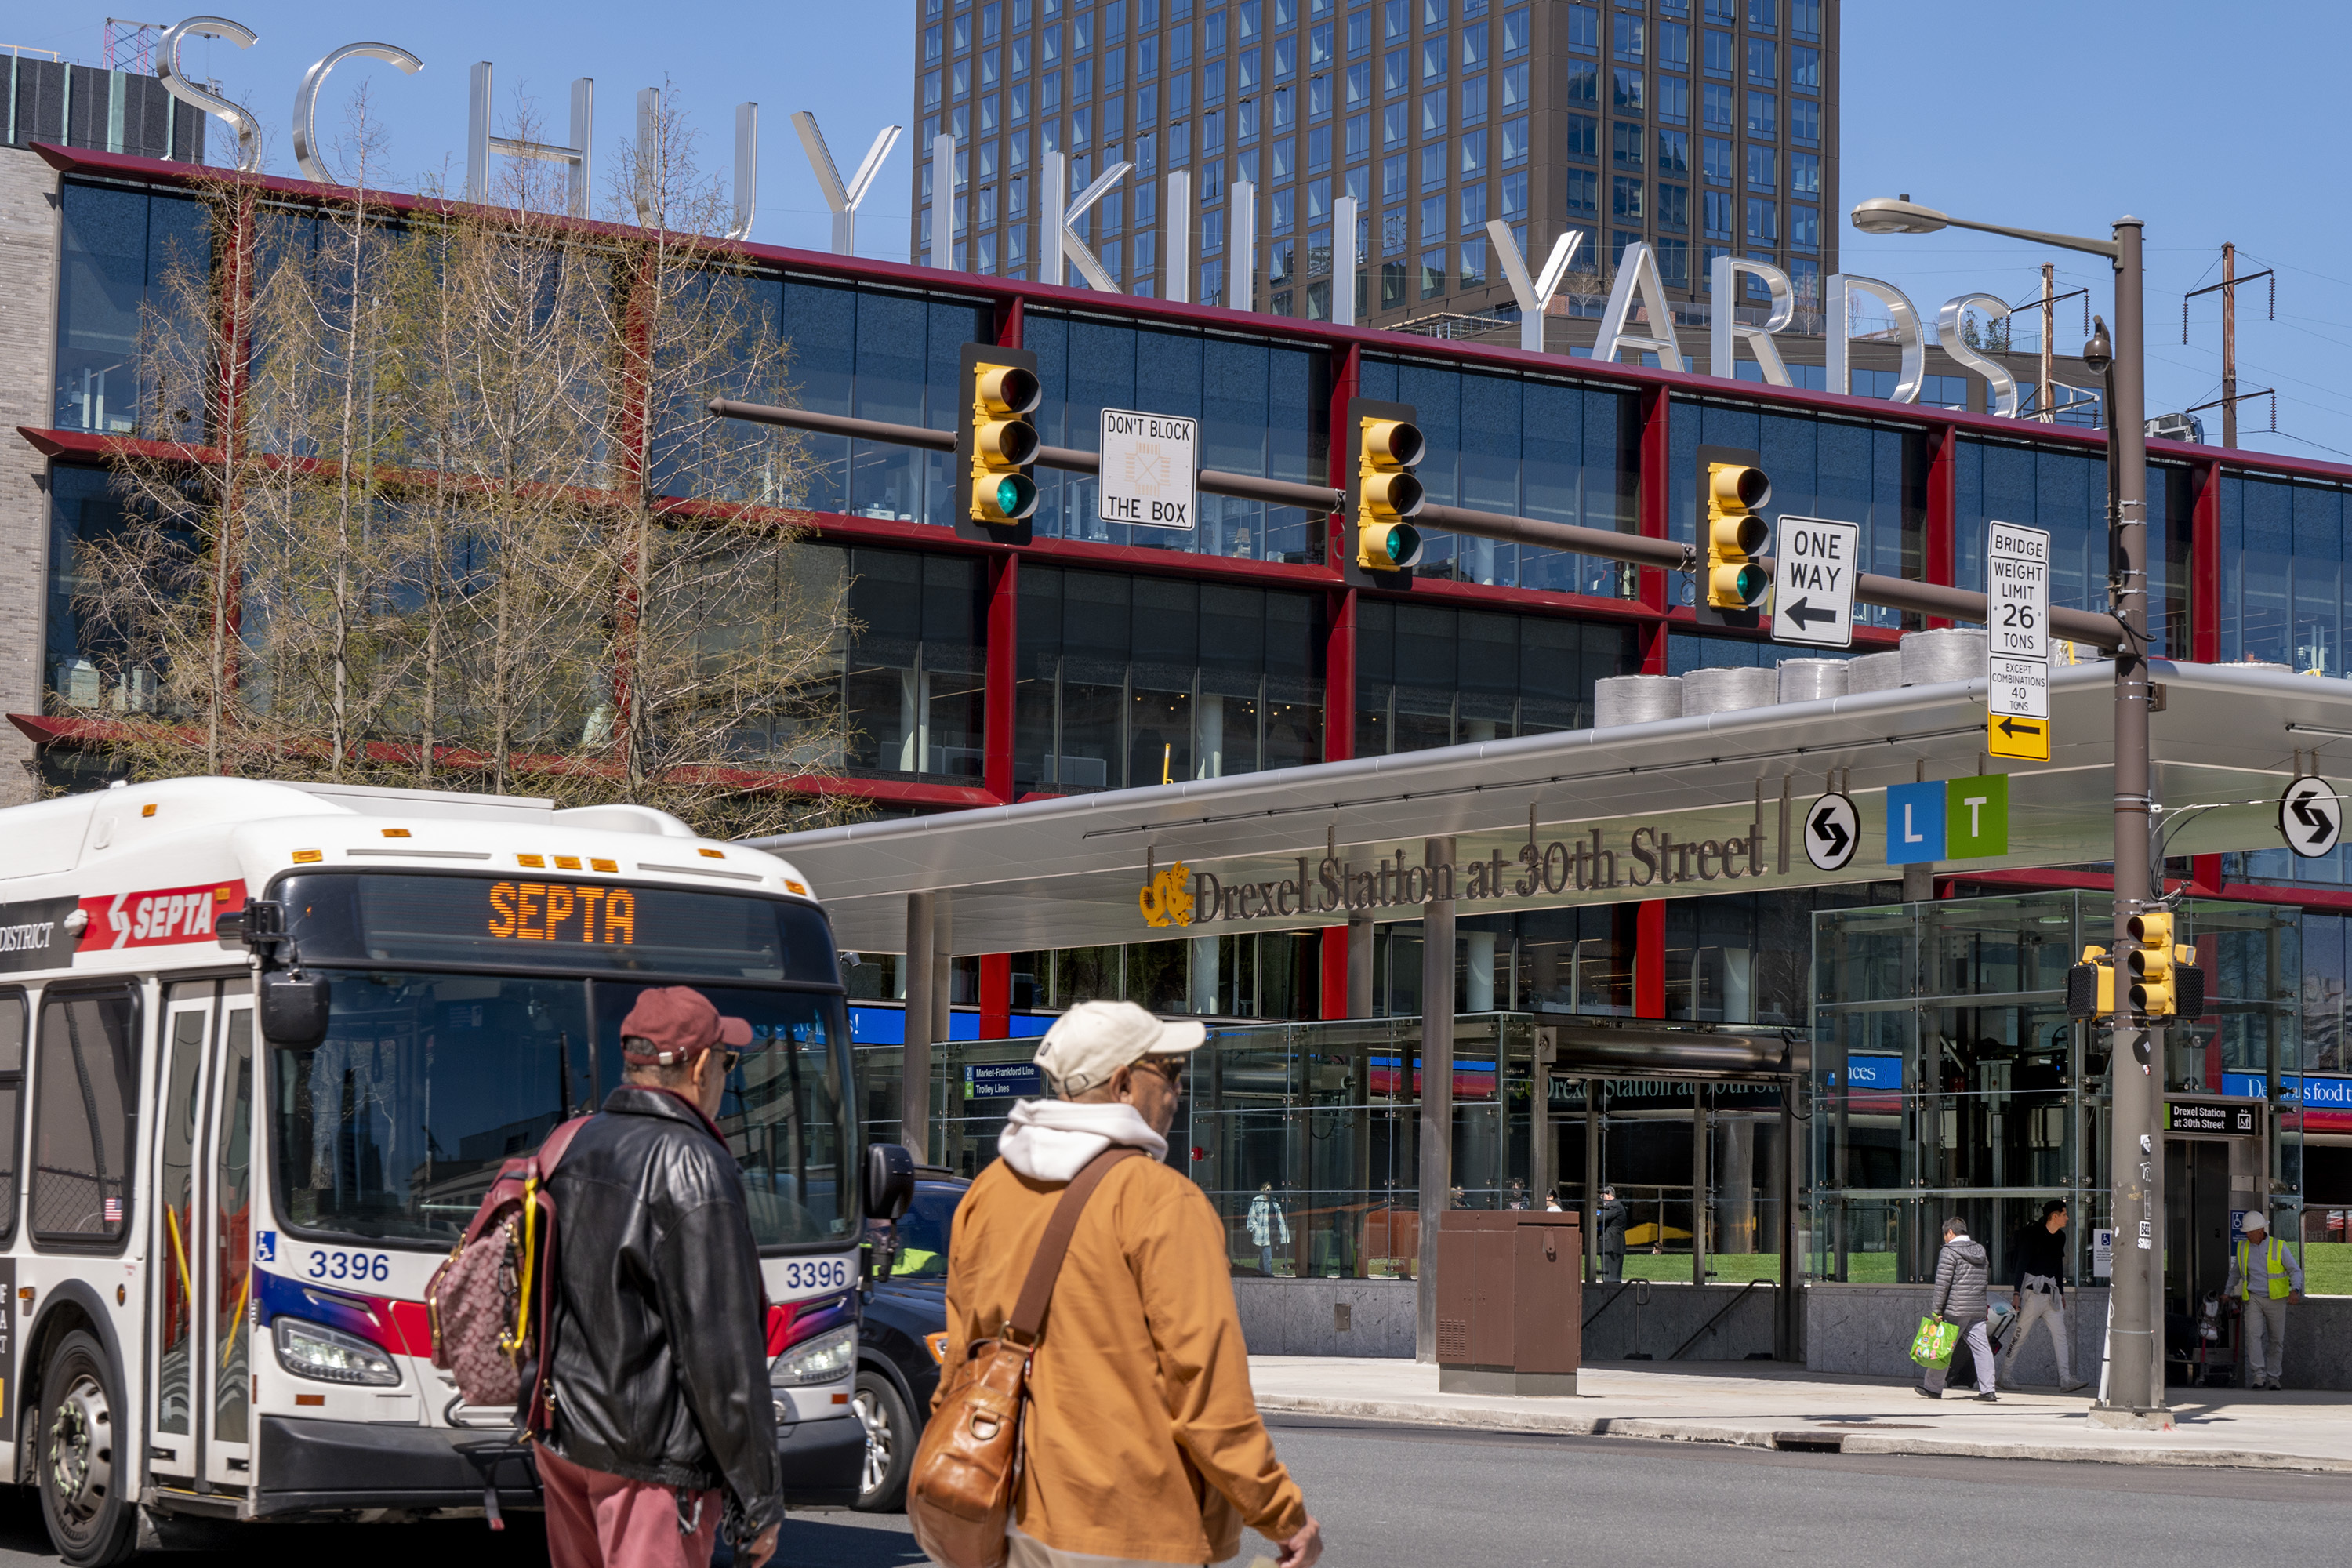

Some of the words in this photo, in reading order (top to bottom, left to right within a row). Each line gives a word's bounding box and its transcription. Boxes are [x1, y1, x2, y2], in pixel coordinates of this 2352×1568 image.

[1486, 218, 2018, 419] YARDS
[1108, 415, 1144, 436] DON'T
[1149, 420, 1190, 441] BLOCK
[1108, 495, 1141, 518] THE
[1152, 500, 1187, 524] BOX
[1794, 530, 1842, 560] ONE
[1995, 535, 2043, 557] BRIDGE
[1791, 562, 1842, 592] WAY
[1994, 562, 2043, 581] WEIGHT
[2002, 583, 2034, 601] LIMIT
[2003, 603, 2034, 629] 26
[2004, 633, 2034, 650] TONS
[1991, 673, 2045, 688] COMBINATIONS
[2005, 663, 2031, 674] EXCEPT
[2011, 688, 2027, 699] 40
[2009, 701, 2029, 711] TONS
[1904, 804, 1923, 843] L
[1964, 796, 1987, 837] T
[1191, 856, 1312, 924] Drexel
[1317, 848, 1459, 913] Station
[1465, 848, 1508, 901] at
[1515, 828, 1621, 898] 30th
[1629, 824, 1769, 887] Street
[133, 892, 213, 940] SEPTA
[488, 882, 635, 944] SEPTA
[975, 1067, 1022, 1077] Market-Frankford
[1022, 1066, 1035, 1075] Line
[975, 1084, 993, 1095] Trolley
[994, 1083, 1010, 1093] Lines
[2313, 1082, 2343, 1102] food
[2173, 1106, 2198, 1116] Drexel
[2199, 1107, 2226, 1118] Station
[2173, 1119, 2183, 1127] at
[2183, 1118, 2201, 1128] 30th
[2201, 1119, 2225, 1130] Street
[308, 1250, 390, 1282] 3396
[787, 1261, 845, 1289] 3396
